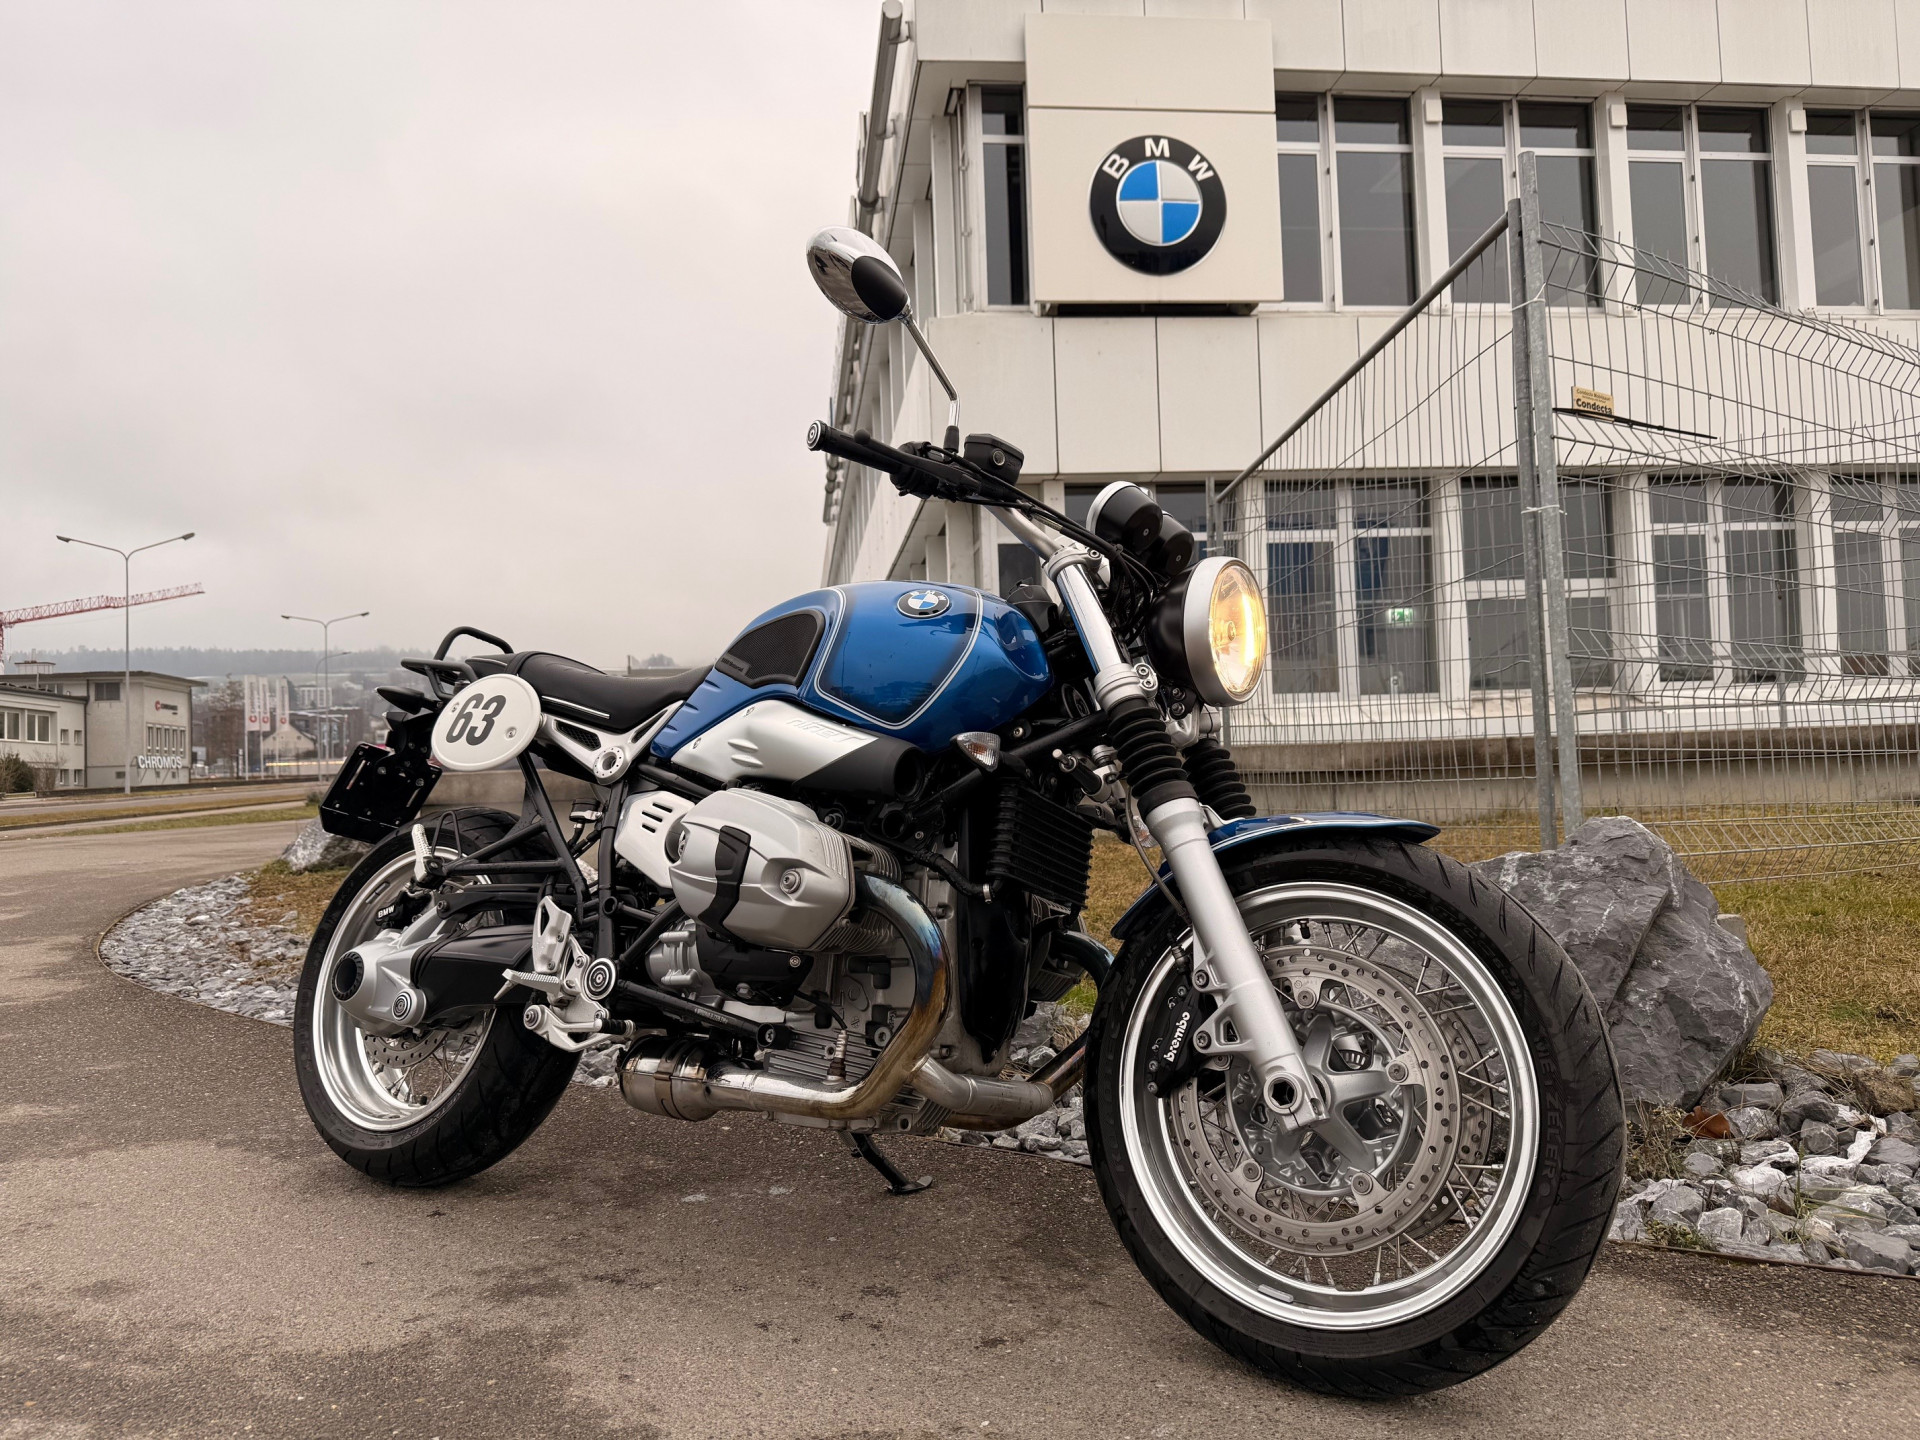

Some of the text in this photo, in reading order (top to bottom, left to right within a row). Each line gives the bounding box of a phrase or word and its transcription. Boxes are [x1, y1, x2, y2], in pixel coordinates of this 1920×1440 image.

[1102, 138, 1215, 182] BMW
[1576, 398, 1612, 415] Condecta
[446, 693, 506, 746] 63
[138, 755, 183, 769] CHROMOS
[378, 904, 395, 918] BMW
[1163, 1011, 1191, 1062] brembo
